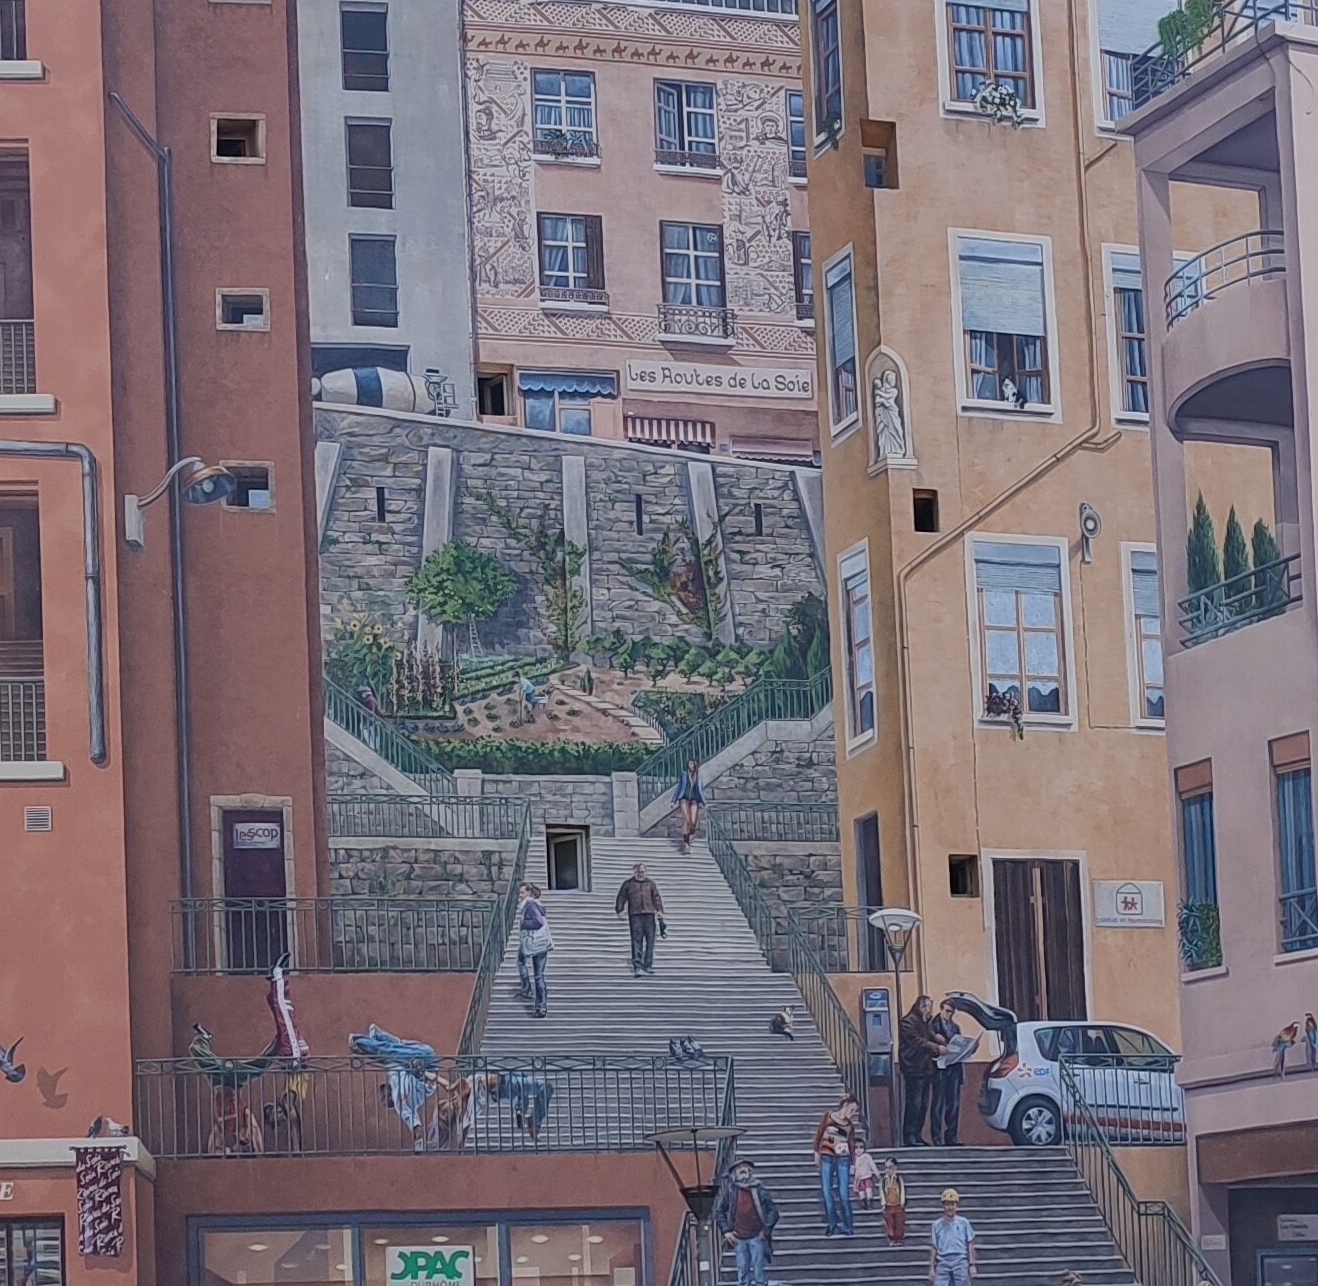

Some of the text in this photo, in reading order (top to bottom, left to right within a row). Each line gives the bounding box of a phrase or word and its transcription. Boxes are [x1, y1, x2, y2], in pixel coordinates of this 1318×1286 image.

[661, 367, 723, 387] Routes
[727, 372, 747, 389] de
[774, 374, 810, 393] Soie
[390, 1250, 470, 1280] OPAC
